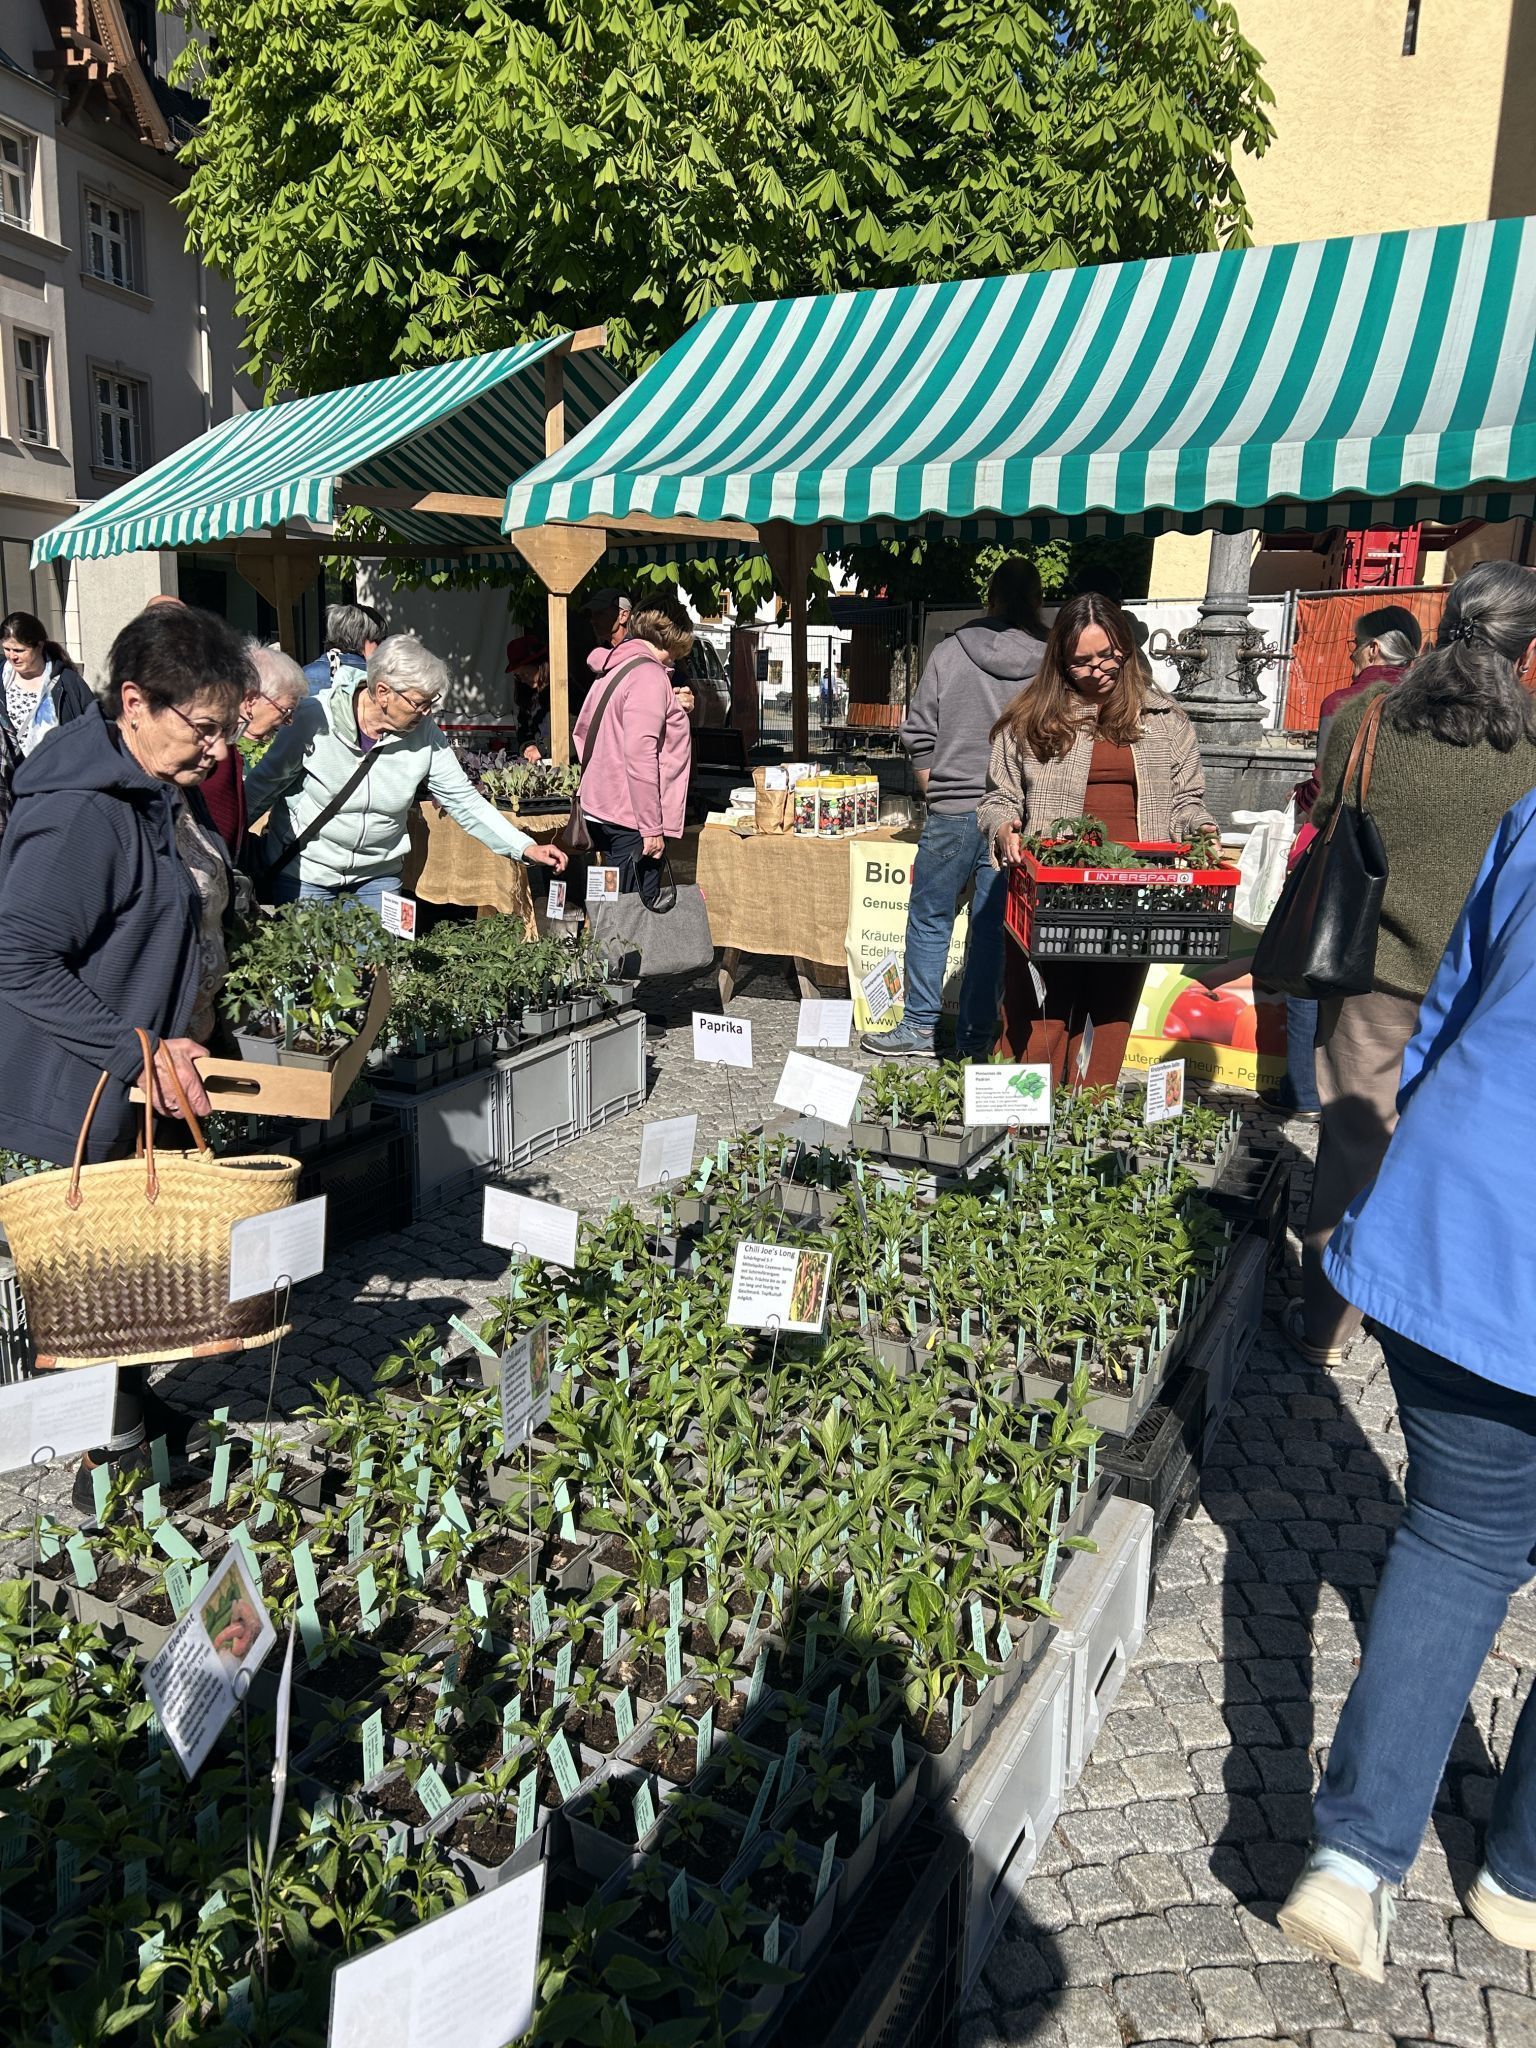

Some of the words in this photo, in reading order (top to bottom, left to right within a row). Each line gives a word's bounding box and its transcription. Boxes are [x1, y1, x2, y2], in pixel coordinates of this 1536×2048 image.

[865, 861, 914, 885] Bio
[1096, 872, 1177, 882] INTERSPAR
[861, 929, 904, 943] Kräuter
[700, 1018, 743, 1034] Paprika
[744, 1245, 760, 1253] Chili
[761, 1246, 778, 1256] Joe's
[779, 1249, 796, 1259] Long
[149, 1649, 168, 1680] Chili
[167, 1611, 195, 1654] Elefant
